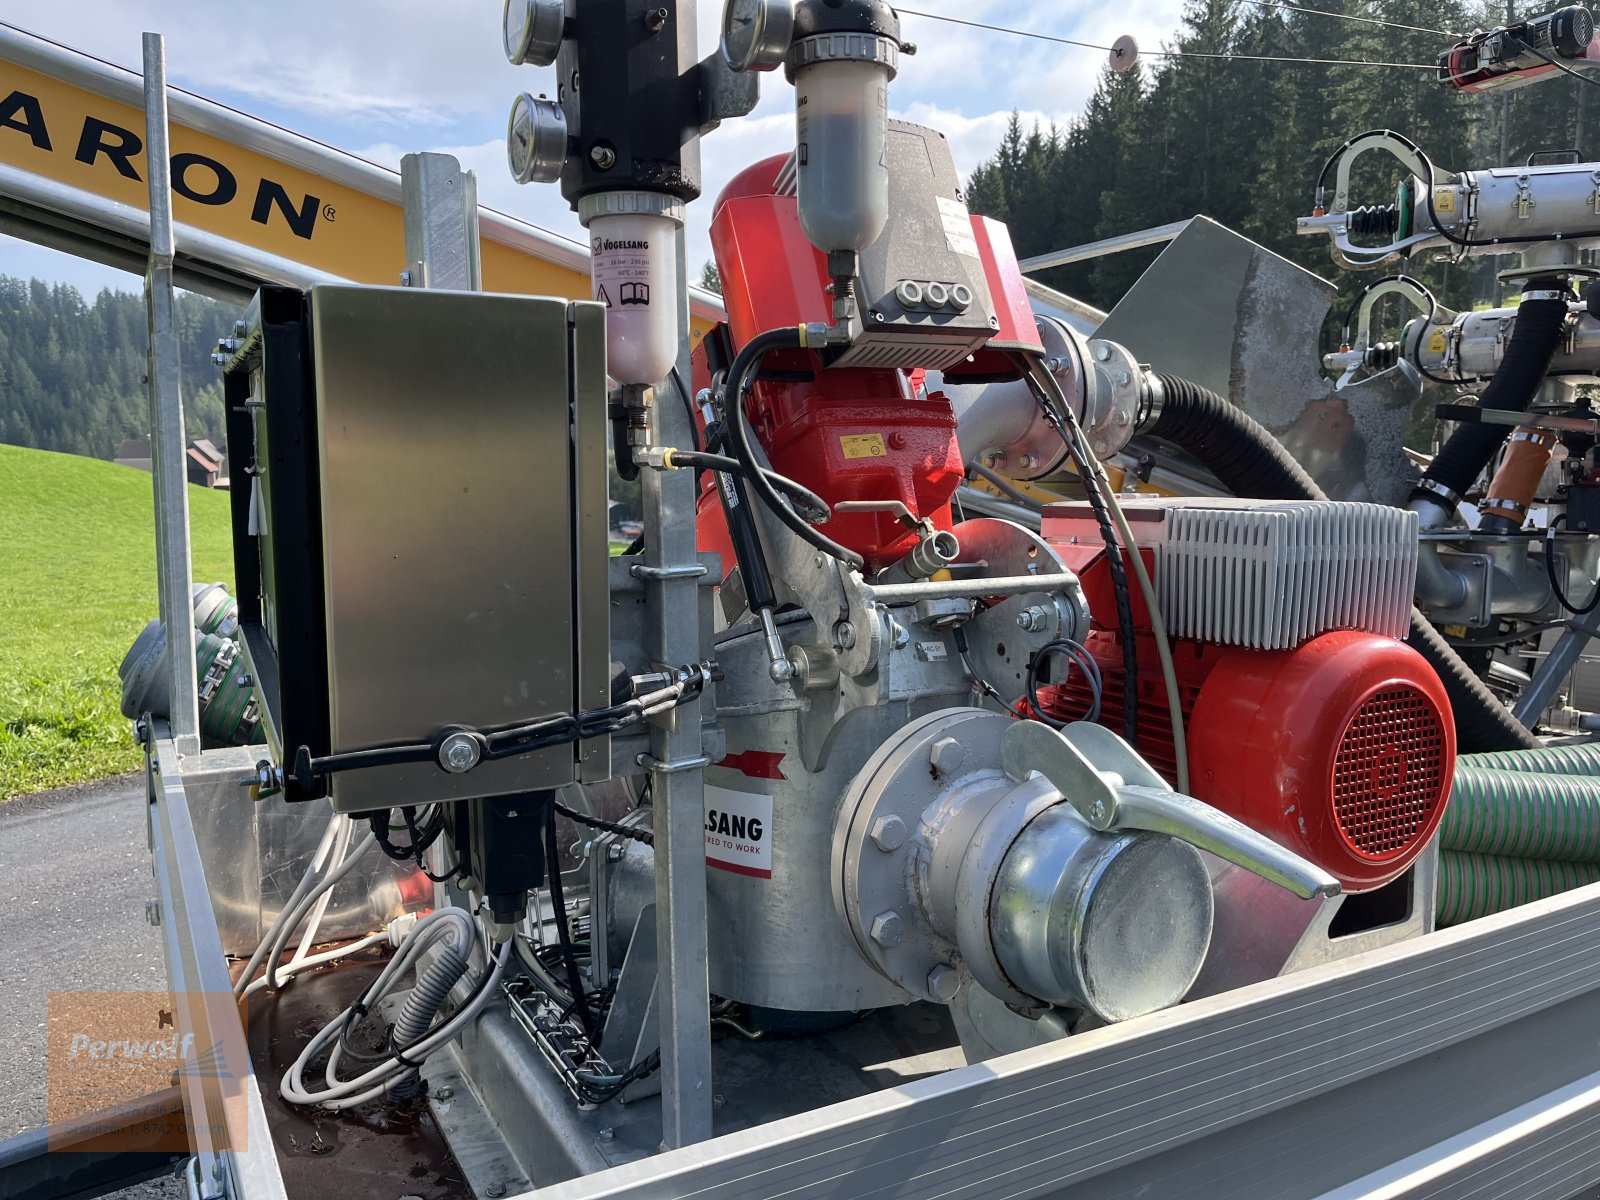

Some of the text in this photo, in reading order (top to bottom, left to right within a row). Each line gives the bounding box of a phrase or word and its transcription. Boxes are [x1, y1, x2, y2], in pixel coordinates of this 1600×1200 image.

[603, 239, 649, 250] VOGELSANG
[704, 809, 763, 841] SANG
[723, 840, 733, 849] TO
[735, 844, 761, 854] WORK
